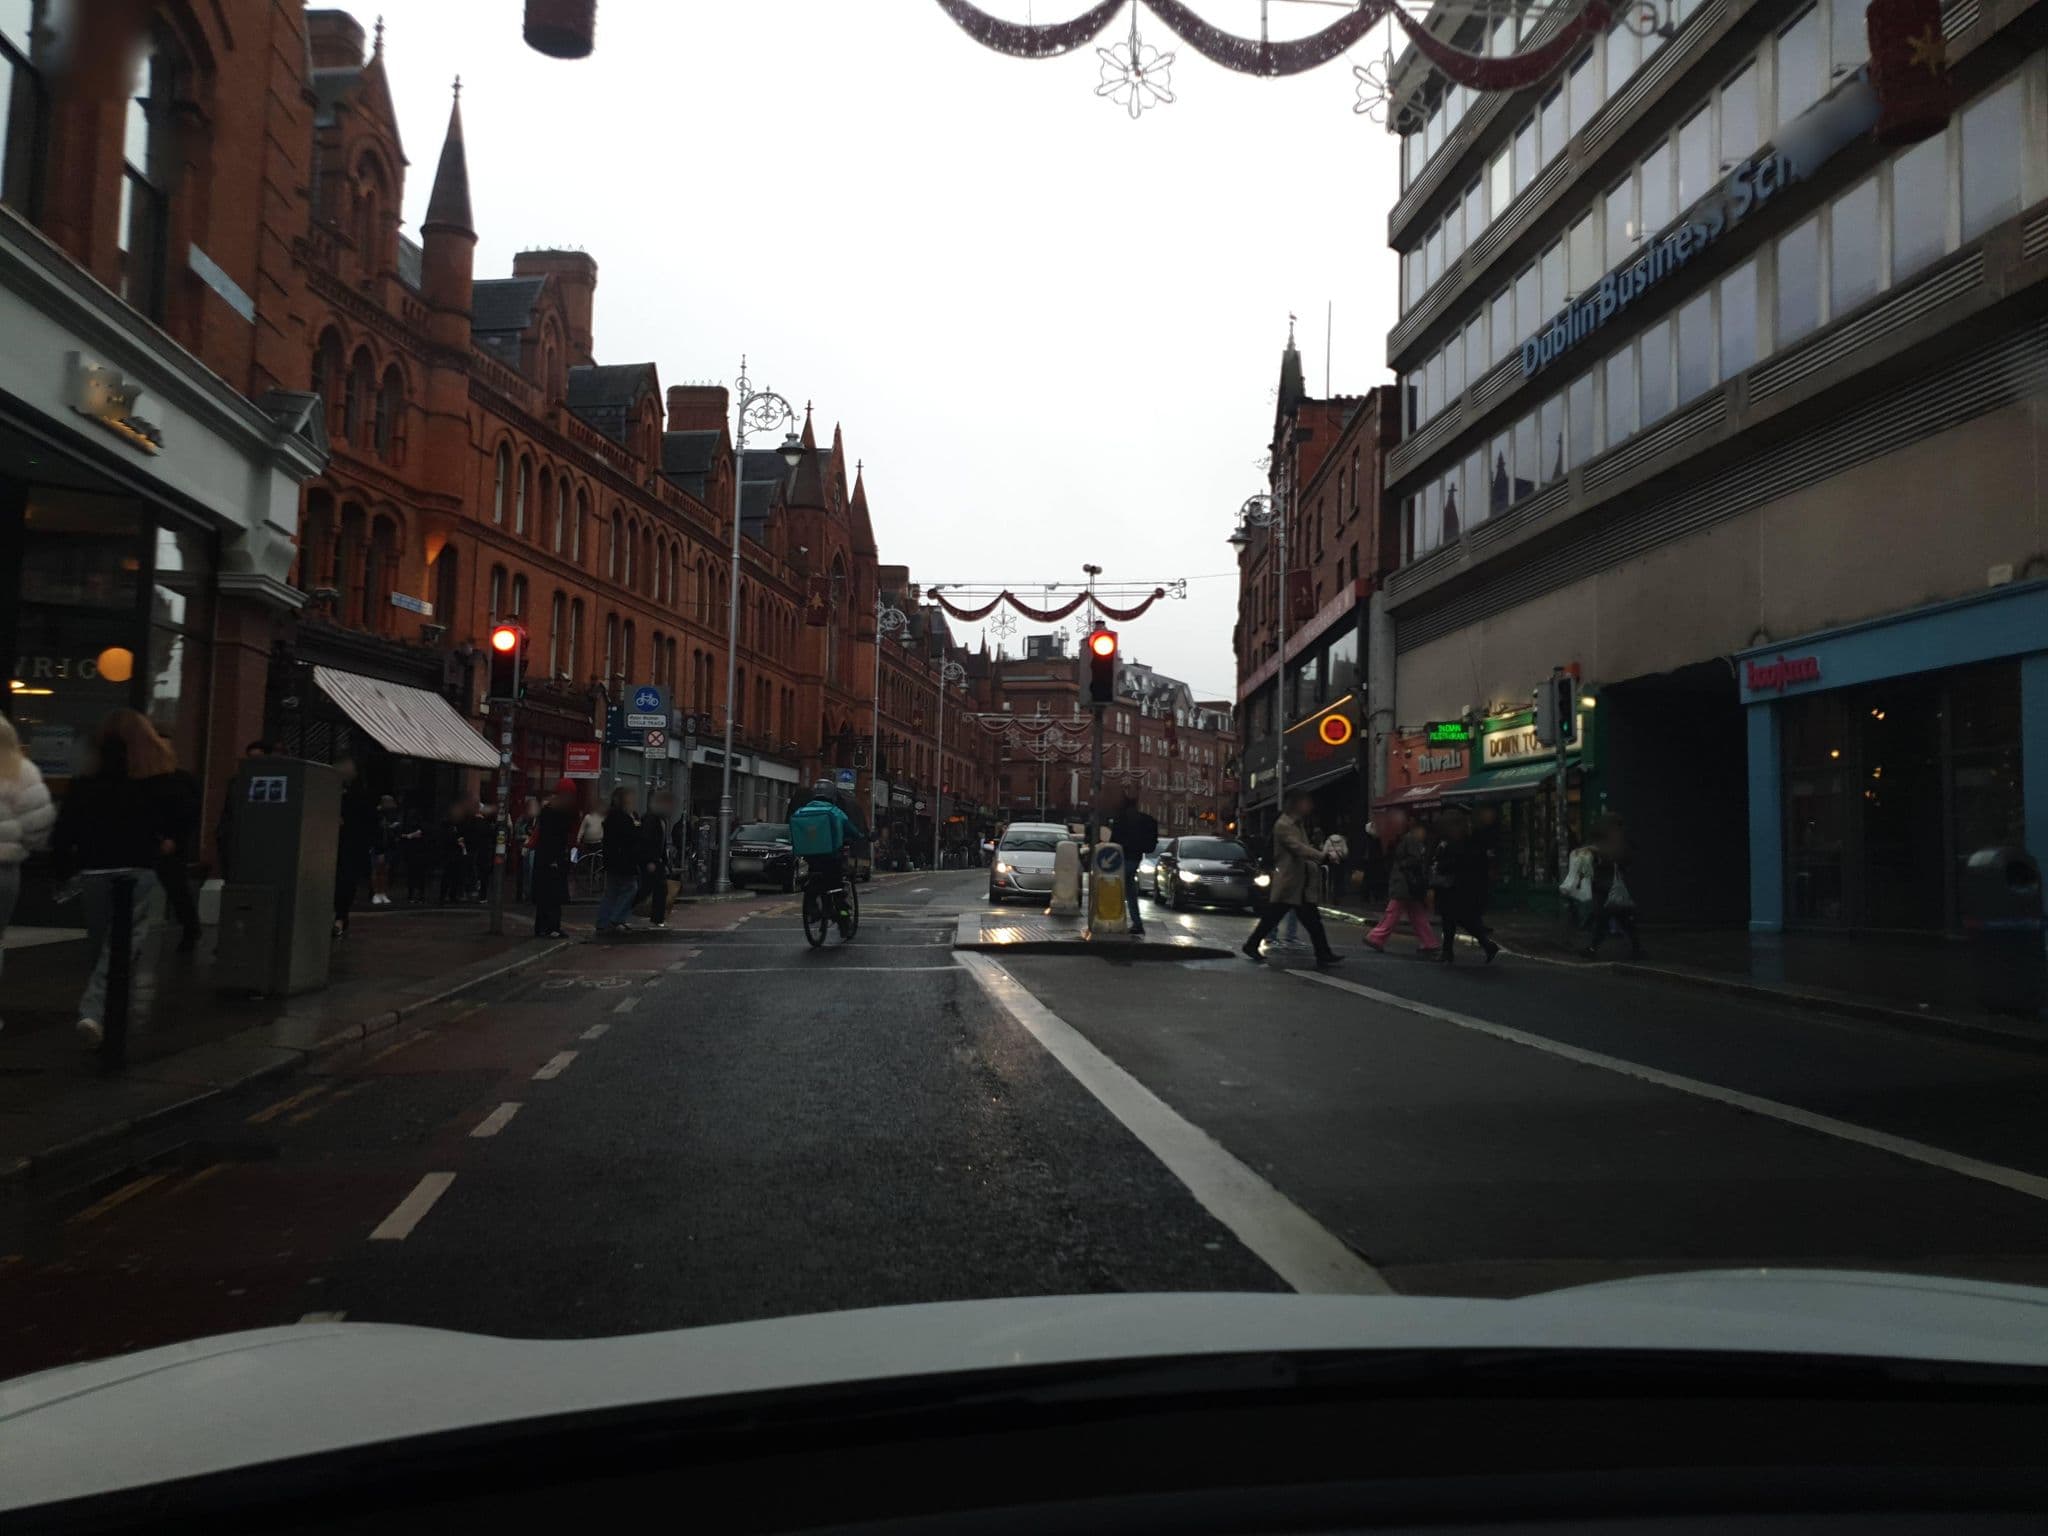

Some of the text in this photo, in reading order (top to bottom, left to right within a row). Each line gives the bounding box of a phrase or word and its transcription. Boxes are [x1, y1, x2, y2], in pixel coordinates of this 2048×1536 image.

[1521, 301, 1597, 377] Dublin
[1599, 206, 1727, 320] Business
[1489, 734, 1520, 757] DOWN
[1418, 748, 1463, 774] Diwali
